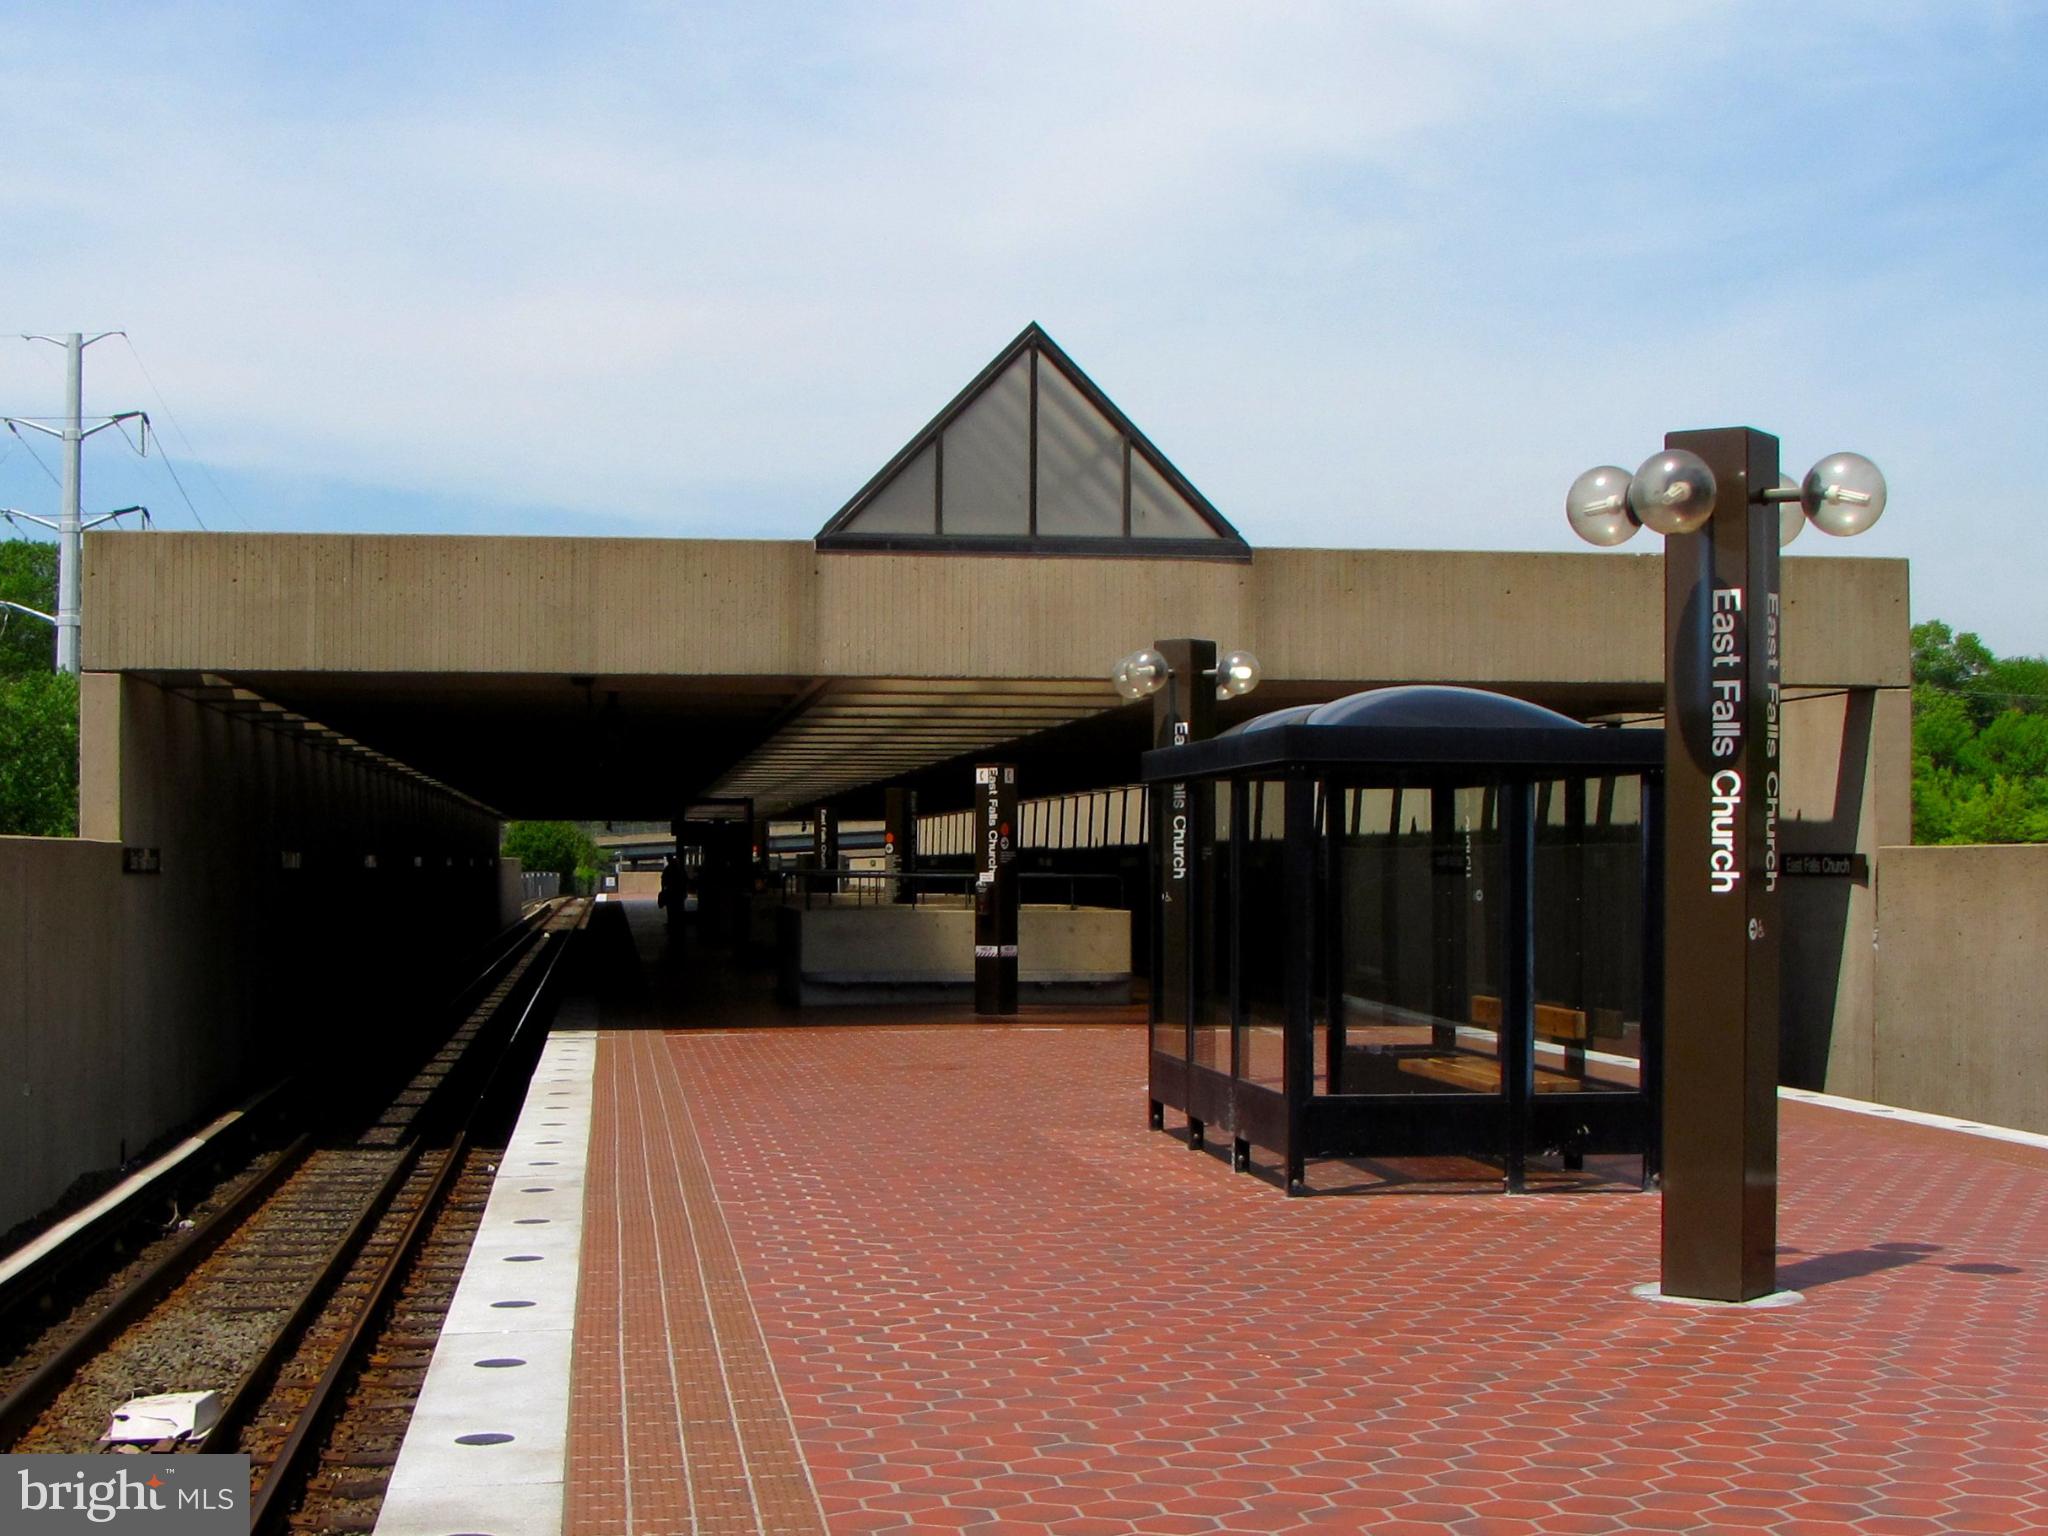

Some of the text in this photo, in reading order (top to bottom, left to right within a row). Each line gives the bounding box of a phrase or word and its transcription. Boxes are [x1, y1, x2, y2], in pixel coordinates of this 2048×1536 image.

[1173, 722, 1188, 879] Ea alls Church
[1711, 588, 1741, 893] East Falls Church
[1766, 592, 1779, 893] East Falls Church
[988, 767, 998, 873] East Falls Church
[1786, 857, 1850, 873] East Falls Church
